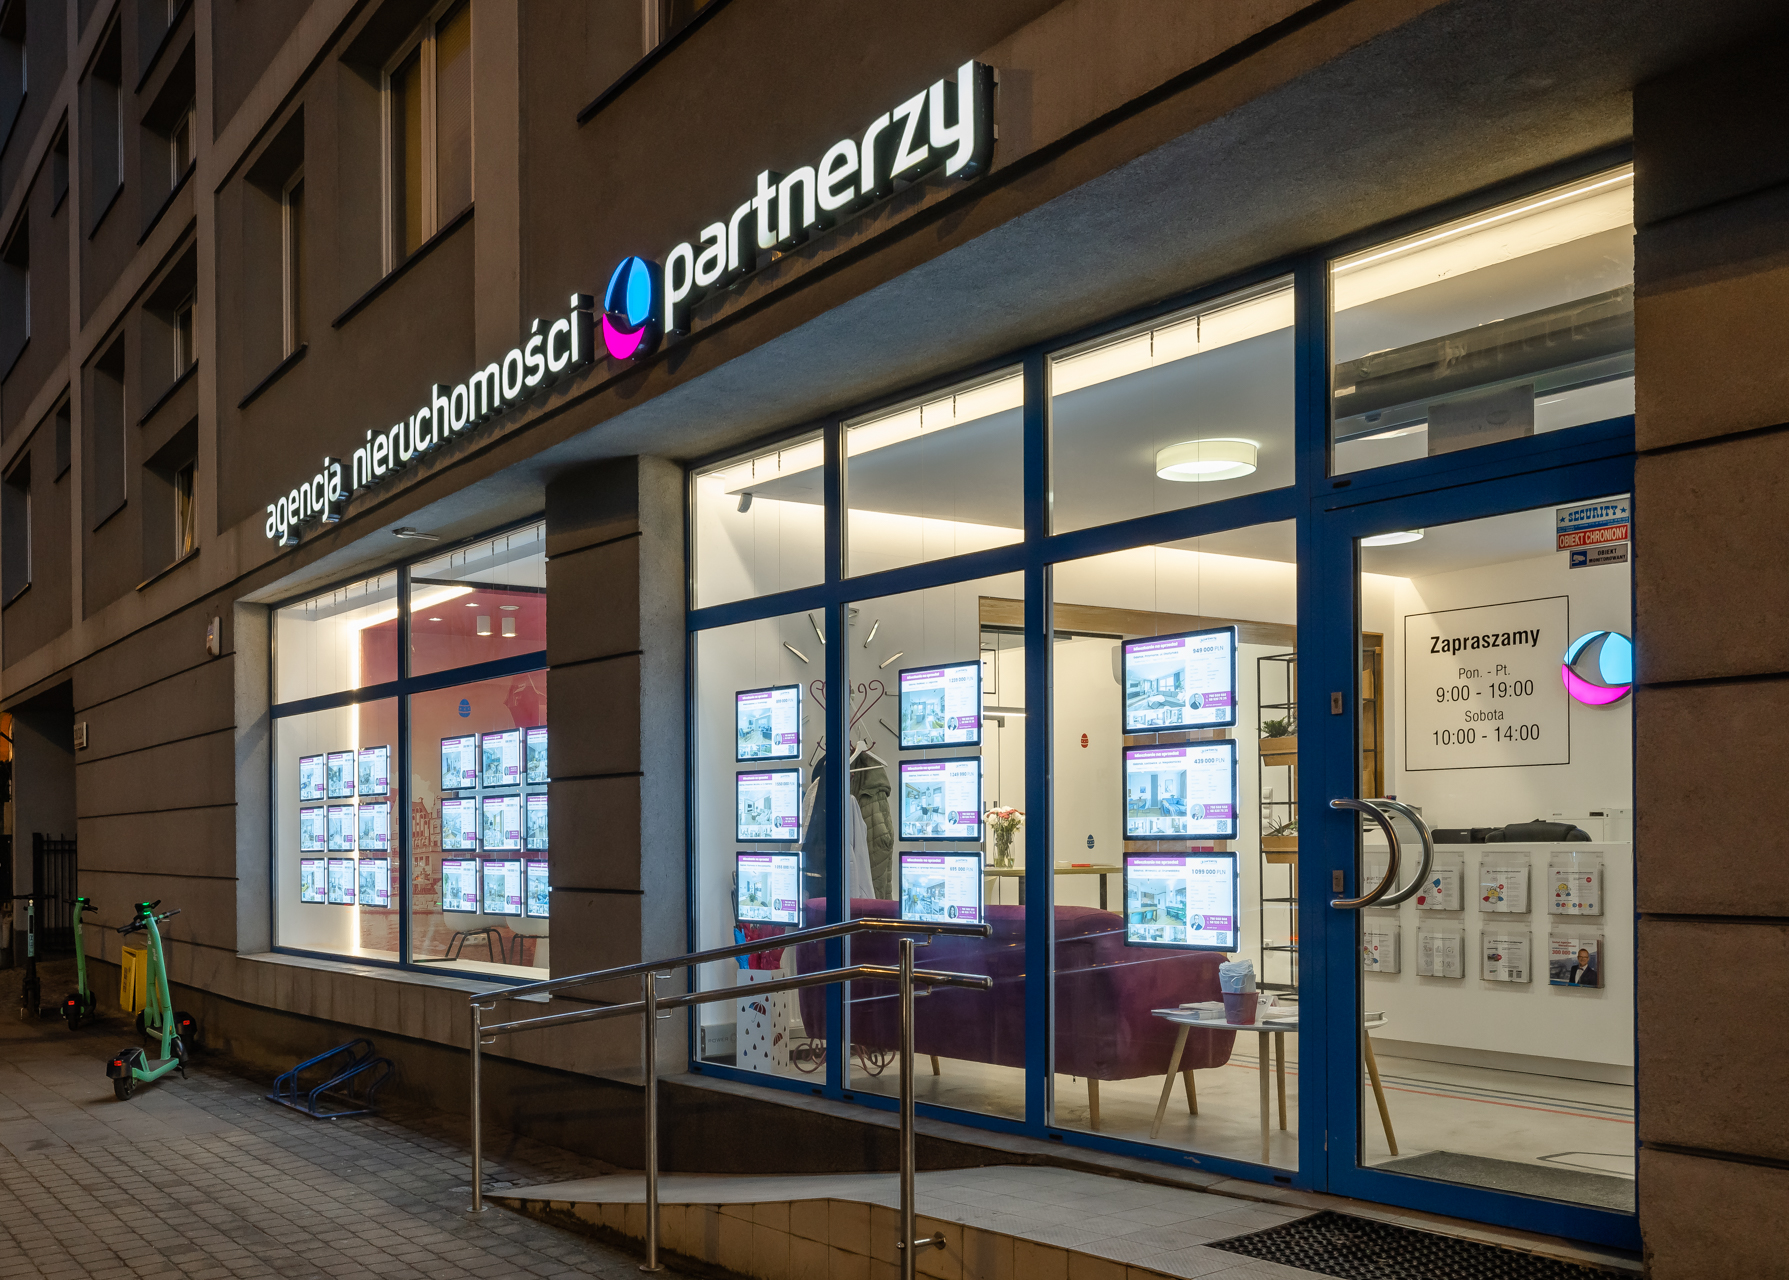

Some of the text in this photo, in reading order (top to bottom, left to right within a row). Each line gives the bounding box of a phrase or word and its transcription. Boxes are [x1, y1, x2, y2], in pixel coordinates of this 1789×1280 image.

[266, 59, 975, 546] agencja nieruchomości partnerzy
[1568, 505, 1618, 522] SECURITY
[1560, 526, 1627, 547] OBIEKT CHRONIONY
[1589, 554, 1626, 563] MONITOROWANY
[1597, 548, 1617, 556] OBIEKT
[1430, 628, 1540, 656] Zapraszamy
[1458, 667, 1483, 680] Pon.
[1495, 664, 1511, 676] Pt.
[1436, 684, 1470, 703] 9:00
[1488, 679, 1534, 699] 19:00
[1464, 709, 1505, 723] Sobota
[1432, 727, 1476, 746] 10:00
[1494, 723, 1540, 742] 14:00
